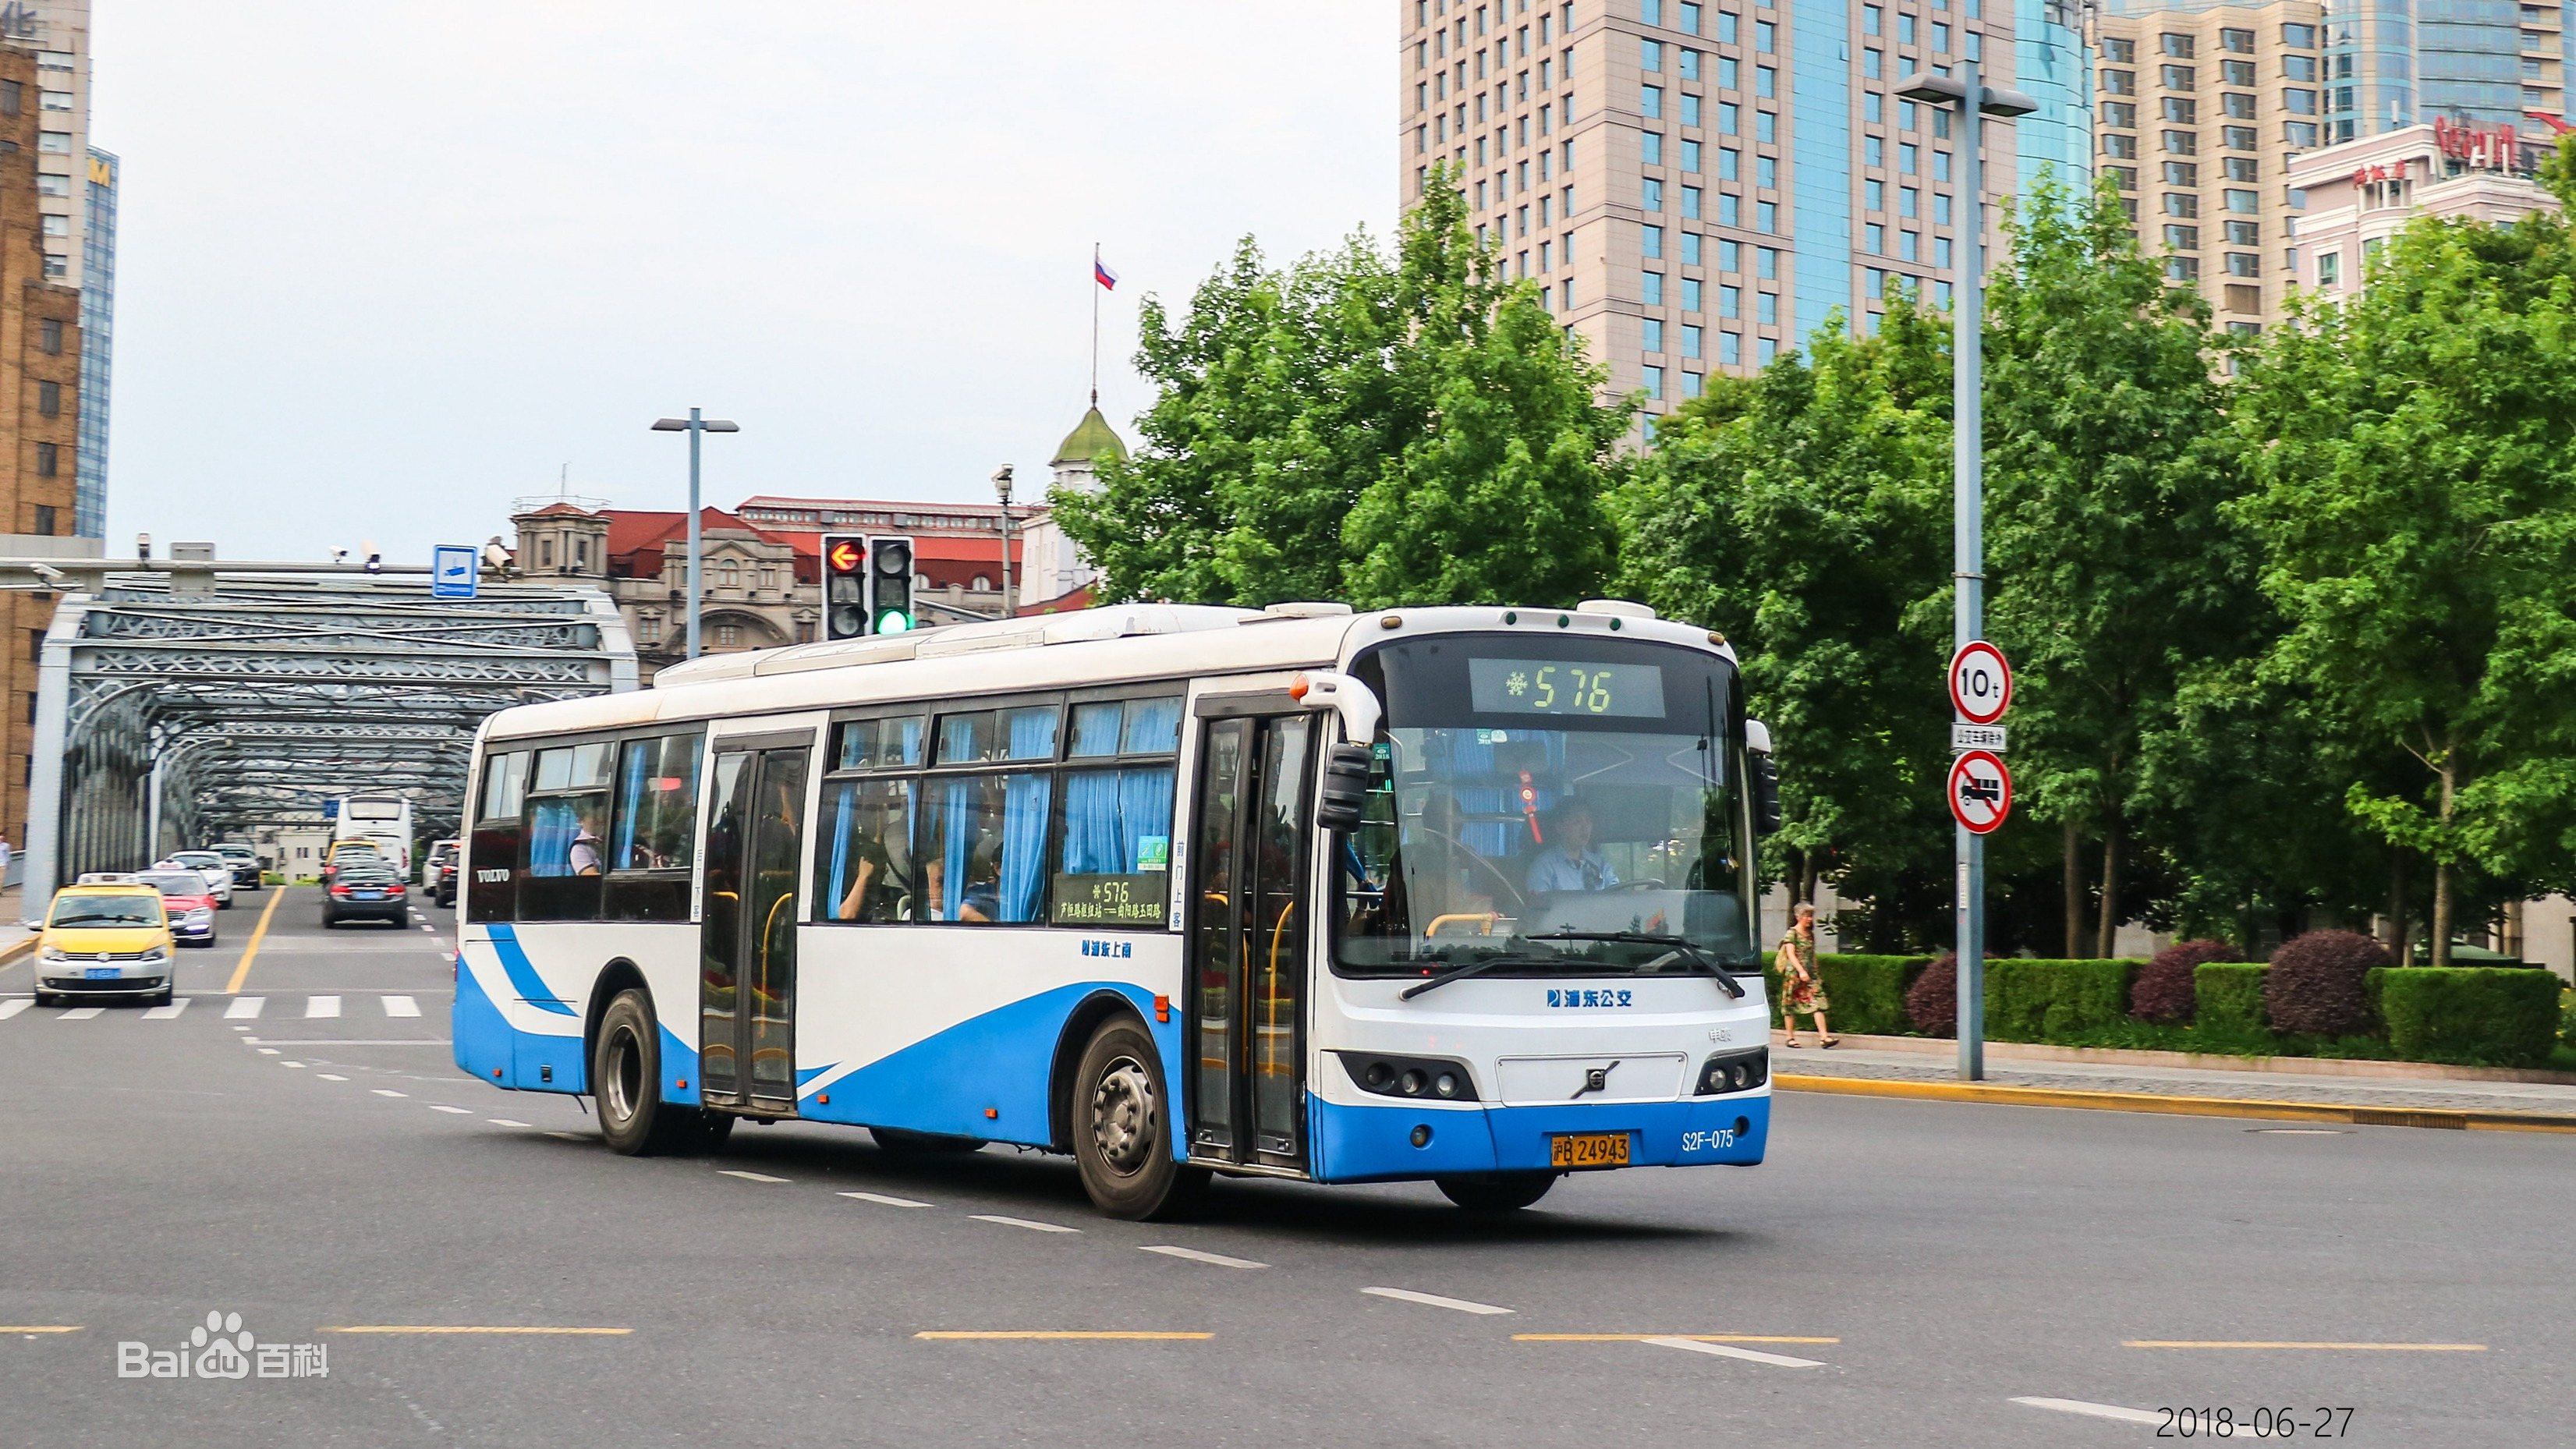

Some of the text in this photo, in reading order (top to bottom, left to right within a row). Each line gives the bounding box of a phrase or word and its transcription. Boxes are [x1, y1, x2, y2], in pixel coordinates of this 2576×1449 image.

[1534, 666, 1612, 712] 576
[477, 868, 511, 884] VOLVO
[1104, 881, 1129, 902] 576
[1090, 941, 1132, 958] 浦东上南
[1564, 989, 1632, 1007] 浦东公交
[1682, 1129, 1734, 1152] S2F-075
